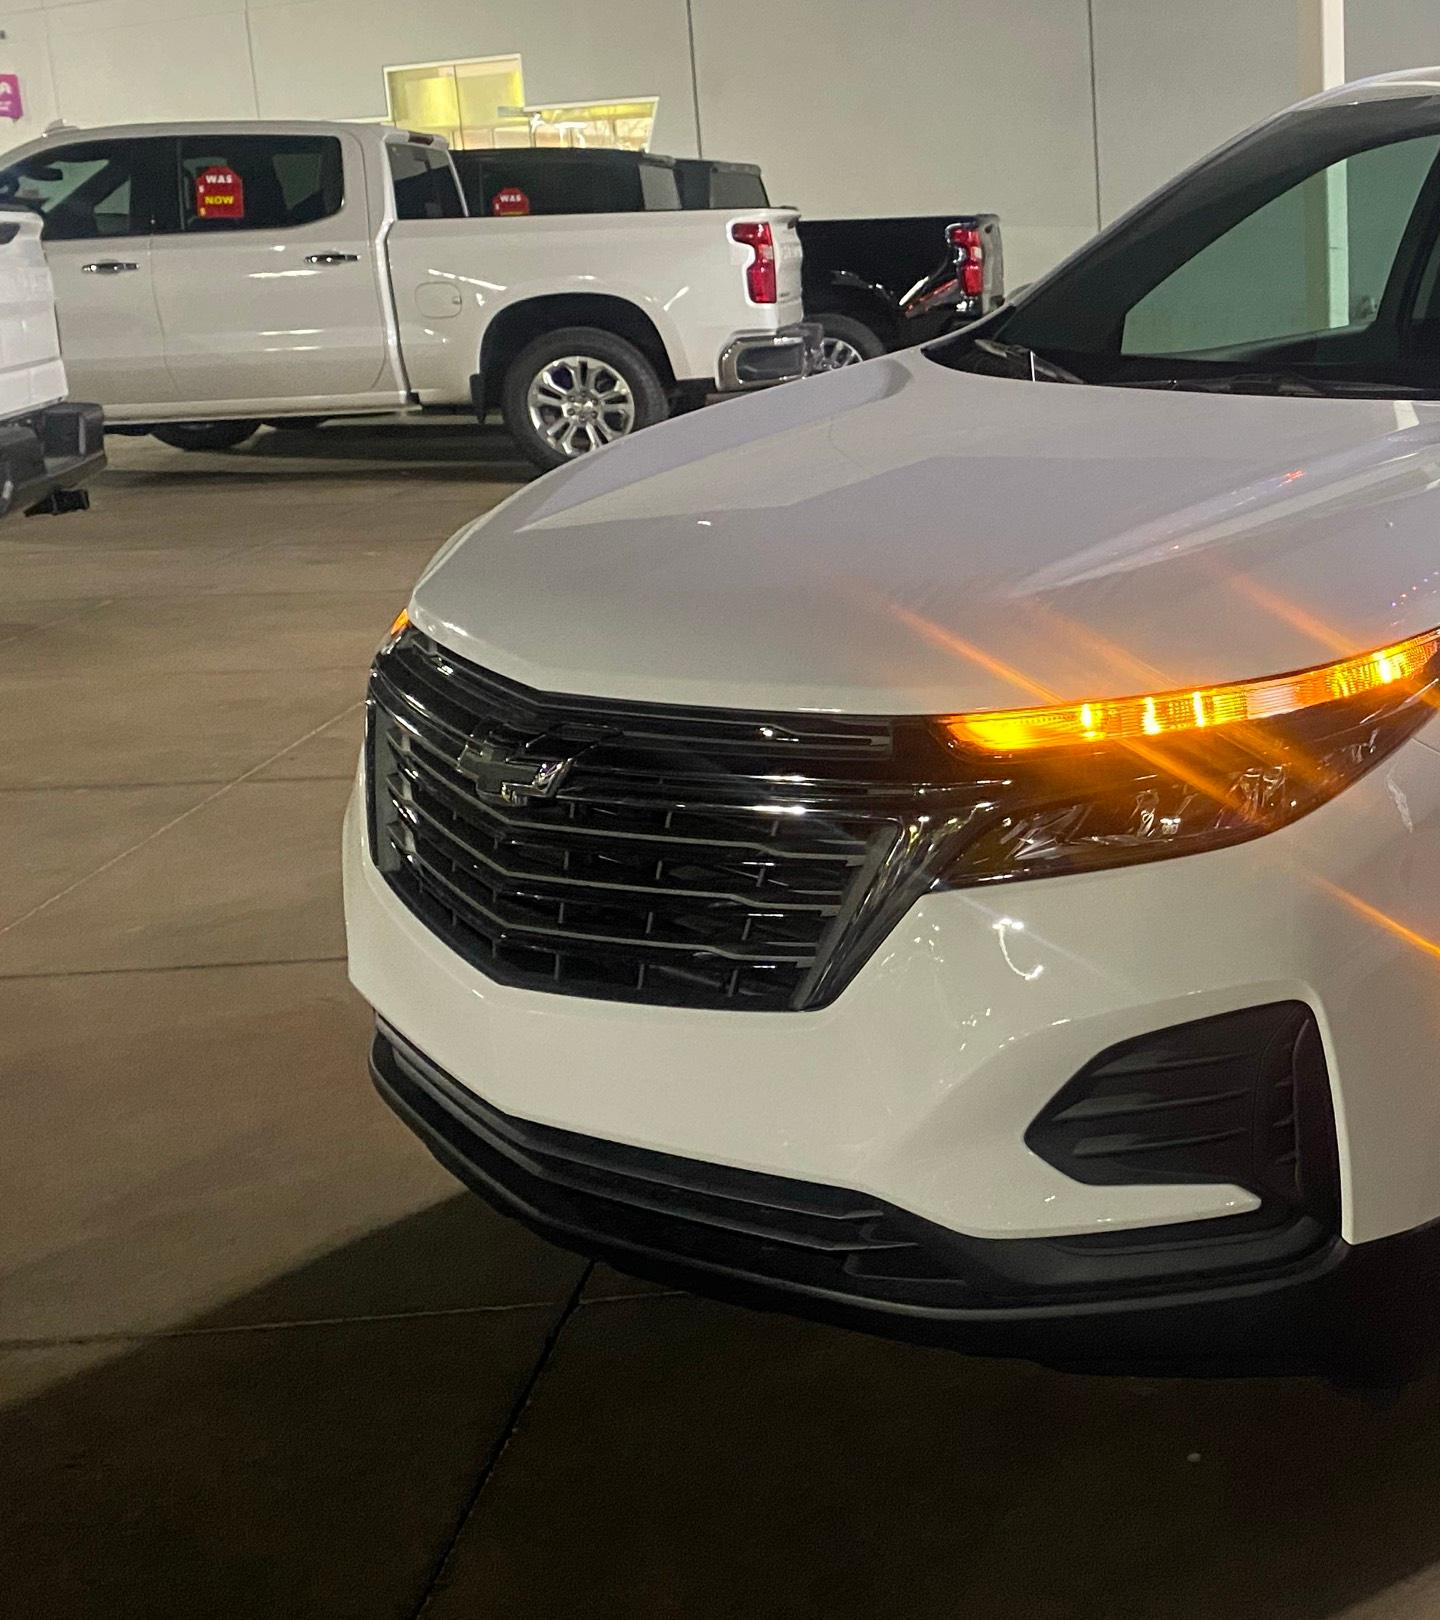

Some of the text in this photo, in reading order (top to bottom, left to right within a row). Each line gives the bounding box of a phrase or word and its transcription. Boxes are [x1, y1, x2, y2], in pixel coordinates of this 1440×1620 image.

[205, 174, 232, 184] WAS
[205, 196, 234, 205] NOW
[500, 194, 521, 202] WAS
